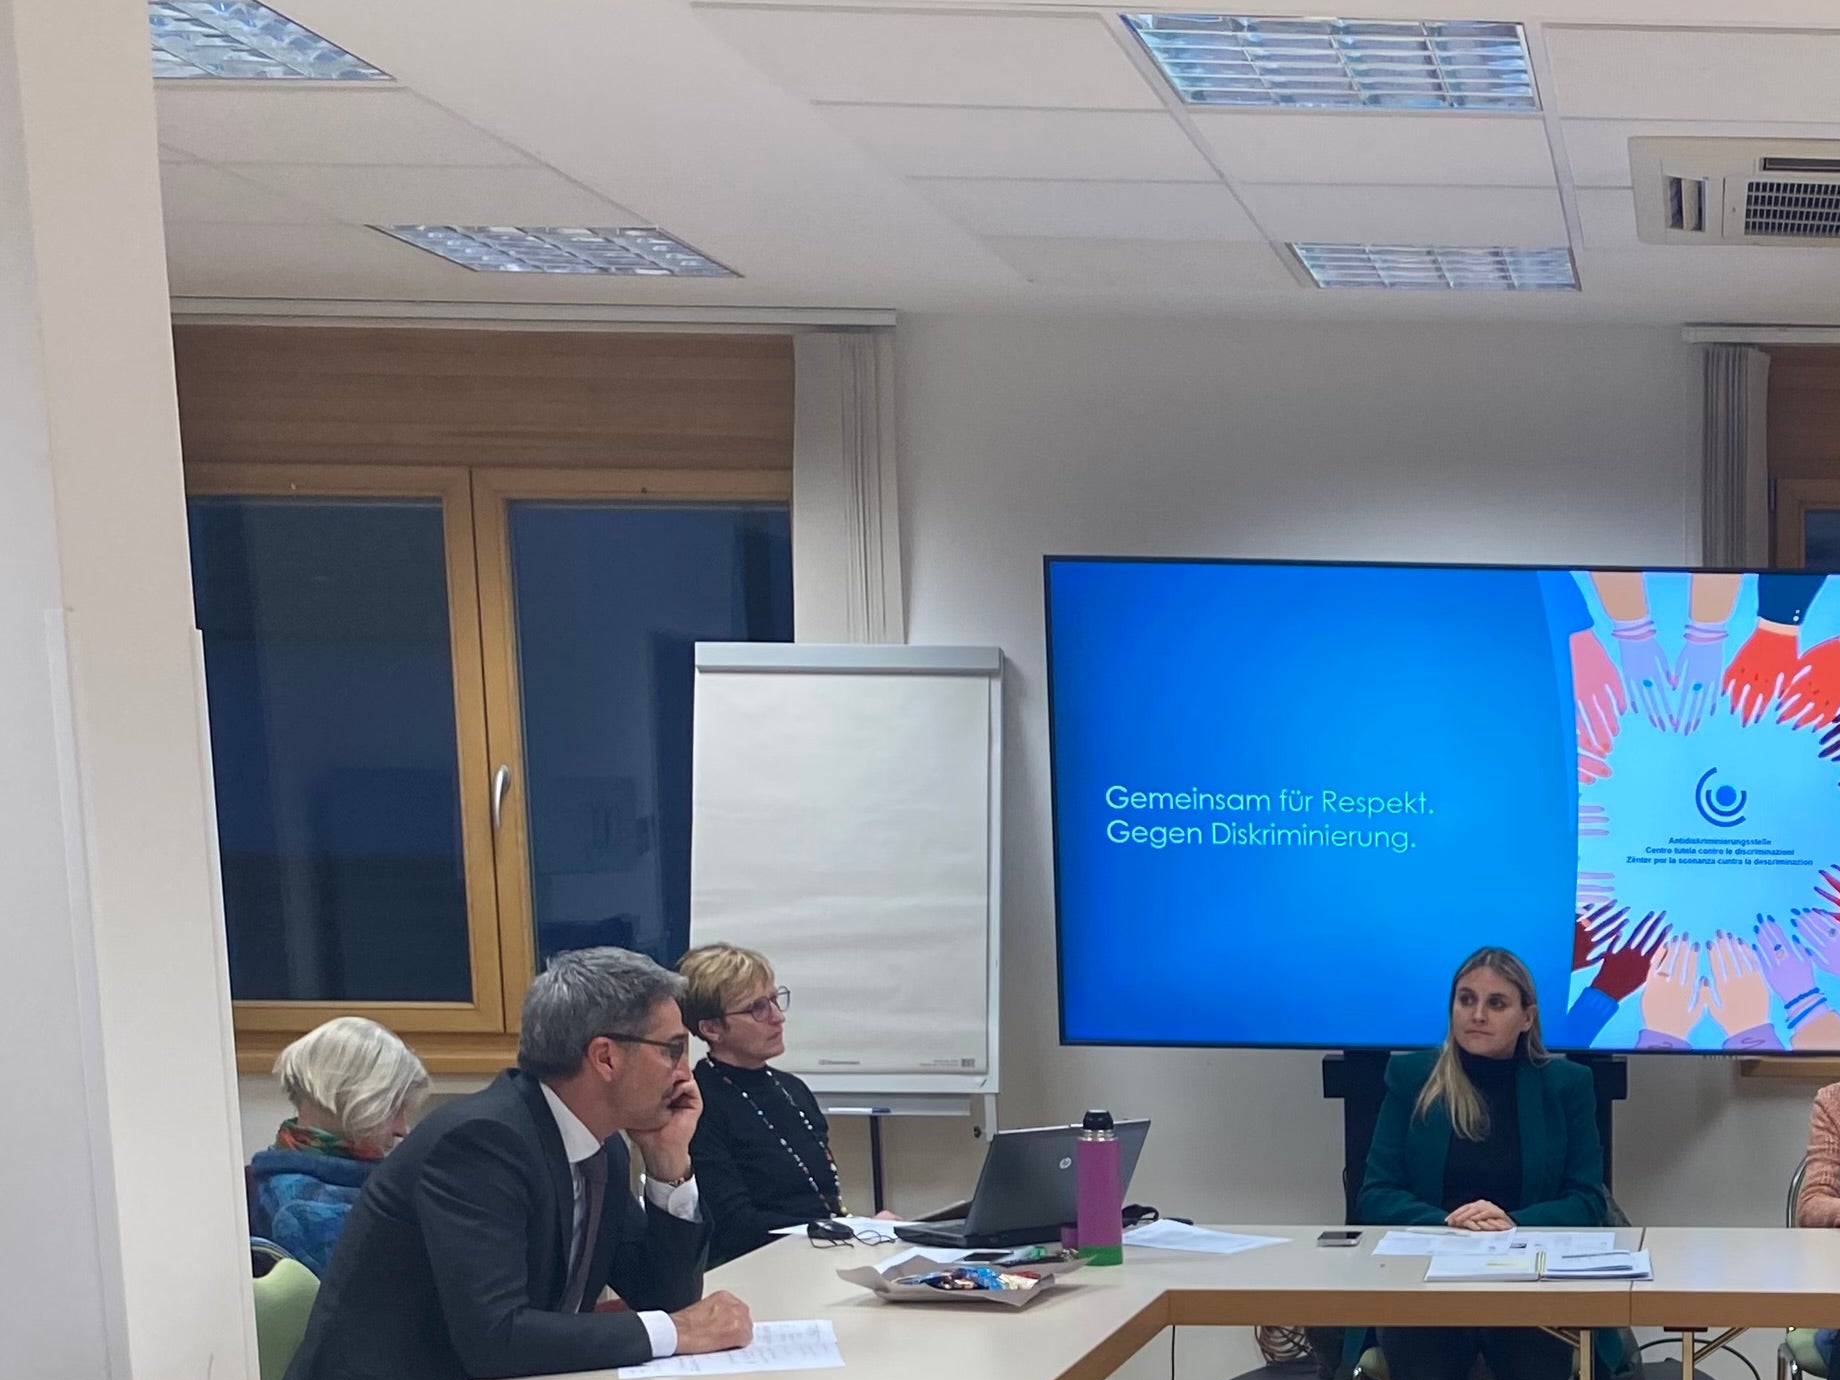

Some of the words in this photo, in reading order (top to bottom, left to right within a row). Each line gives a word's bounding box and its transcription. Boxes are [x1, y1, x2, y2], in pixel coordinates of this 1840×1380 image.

[1105, 785, 1270, 811] Gemeinsam
[1280, 789, 1313, 812] für
[1323, 790, 1434, 818] Respekt.
[1106, 820, 1202, 849] Gegen
[1212, 822, 1416, 853] Diskriminierung.
[1646, 847, 1672, 855] Centro
